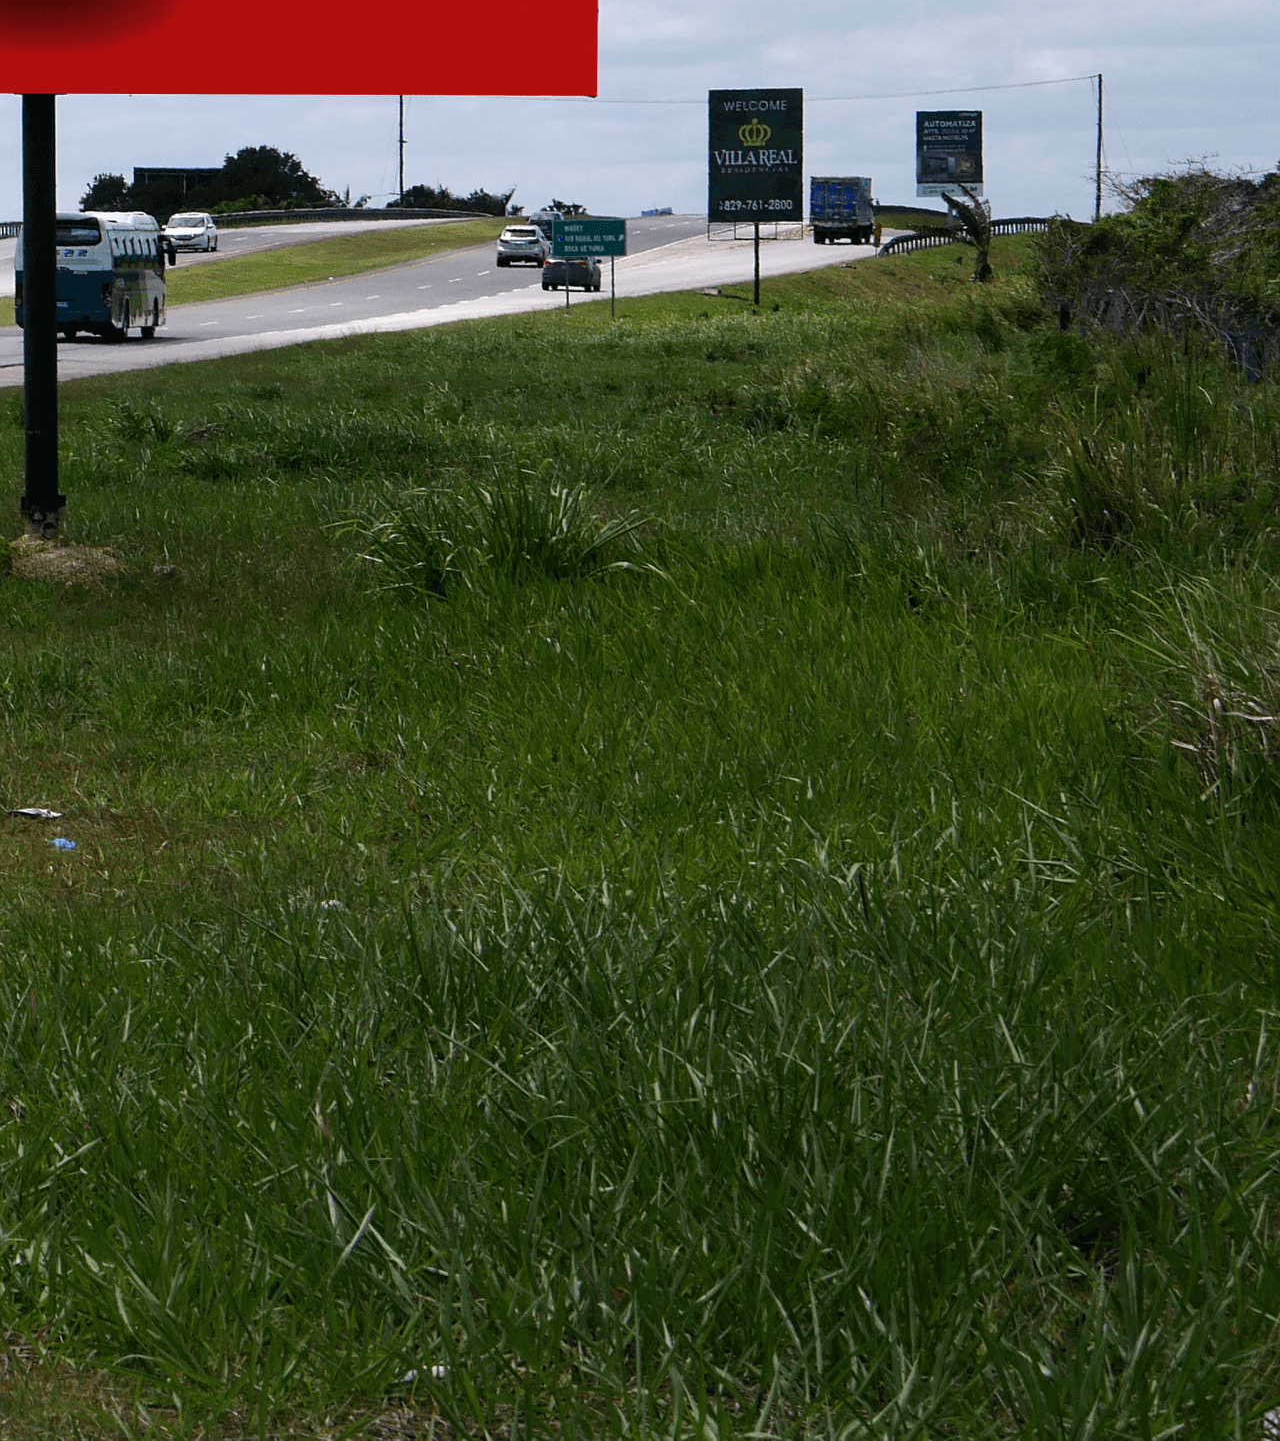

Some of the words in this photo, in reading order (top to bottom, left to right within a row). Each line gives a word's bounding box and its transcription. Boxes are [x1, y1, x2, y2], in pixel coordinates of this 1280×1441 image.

[723, 100, 788, 111] WELCOME
[713, 149, 758, 166] VILLA
[758, 149, 798, 167] REAL
